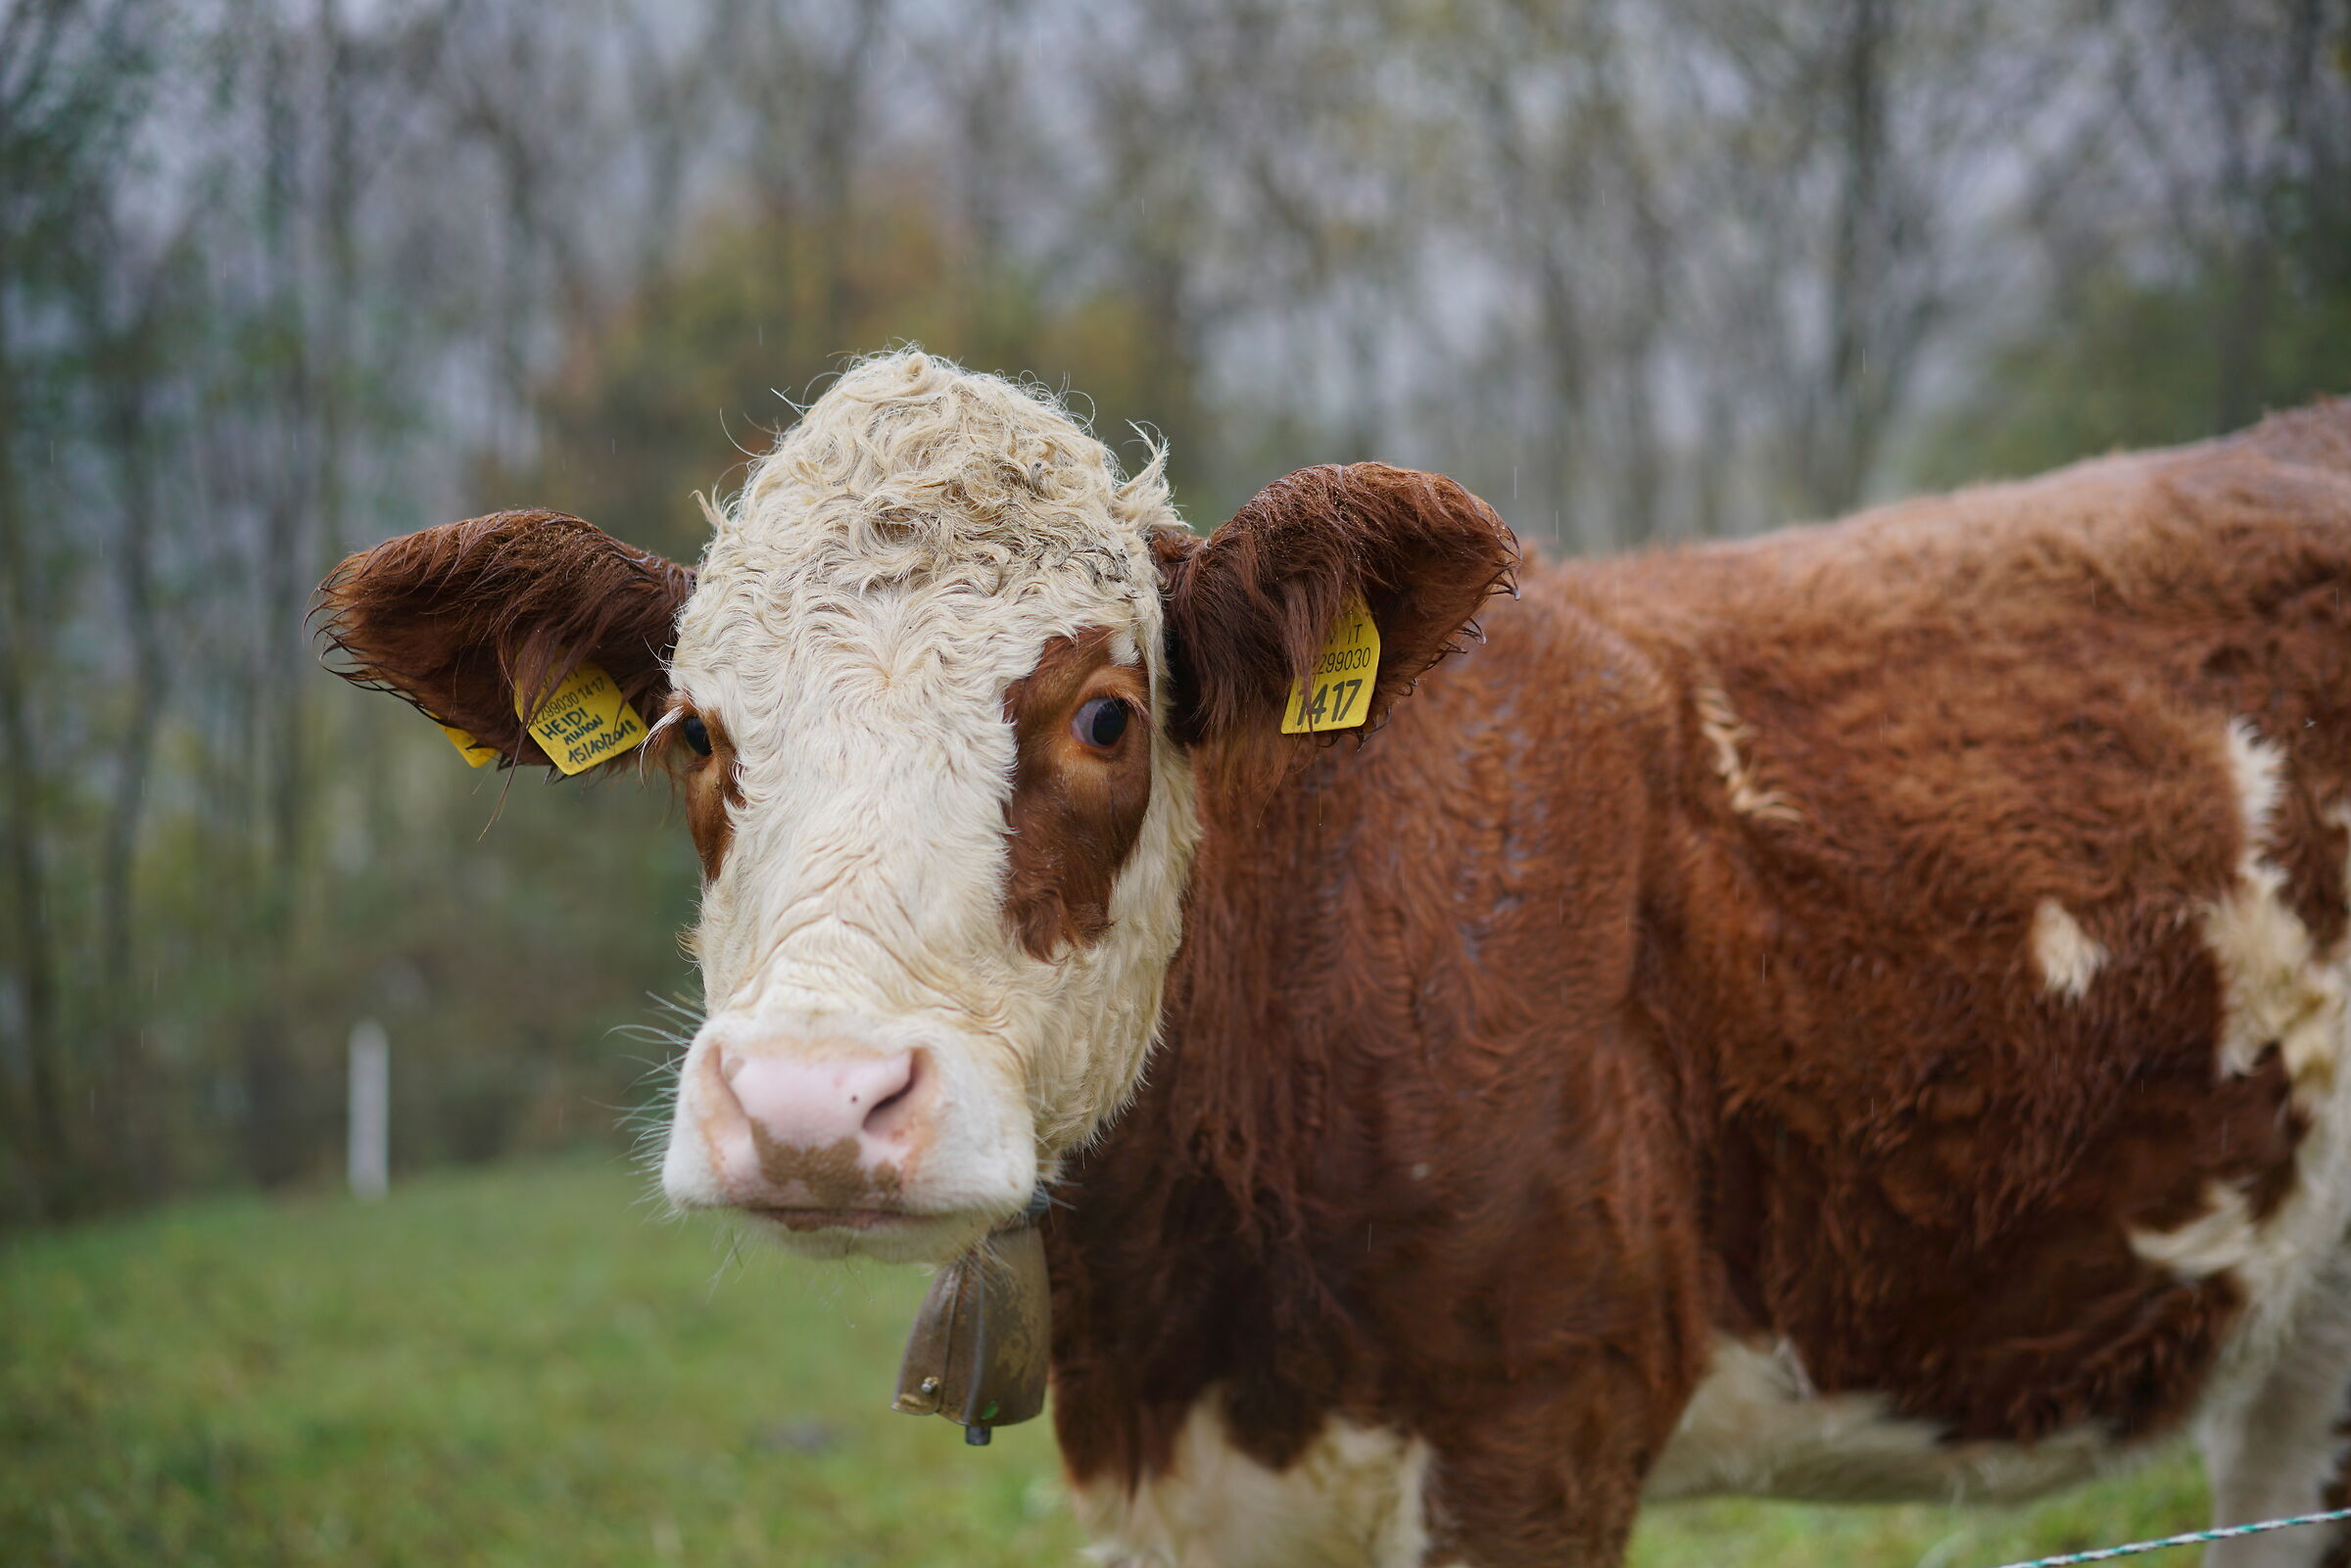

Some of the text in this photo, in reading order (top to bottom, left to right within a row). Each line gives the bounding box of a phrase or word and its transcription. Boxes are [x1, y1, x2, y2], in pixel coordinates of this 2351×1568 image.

[1314, 647, 1370, 674] 299030
[1297, 679, 1363, 726] 1417
[539, 707, 589, 741] HEIDI
